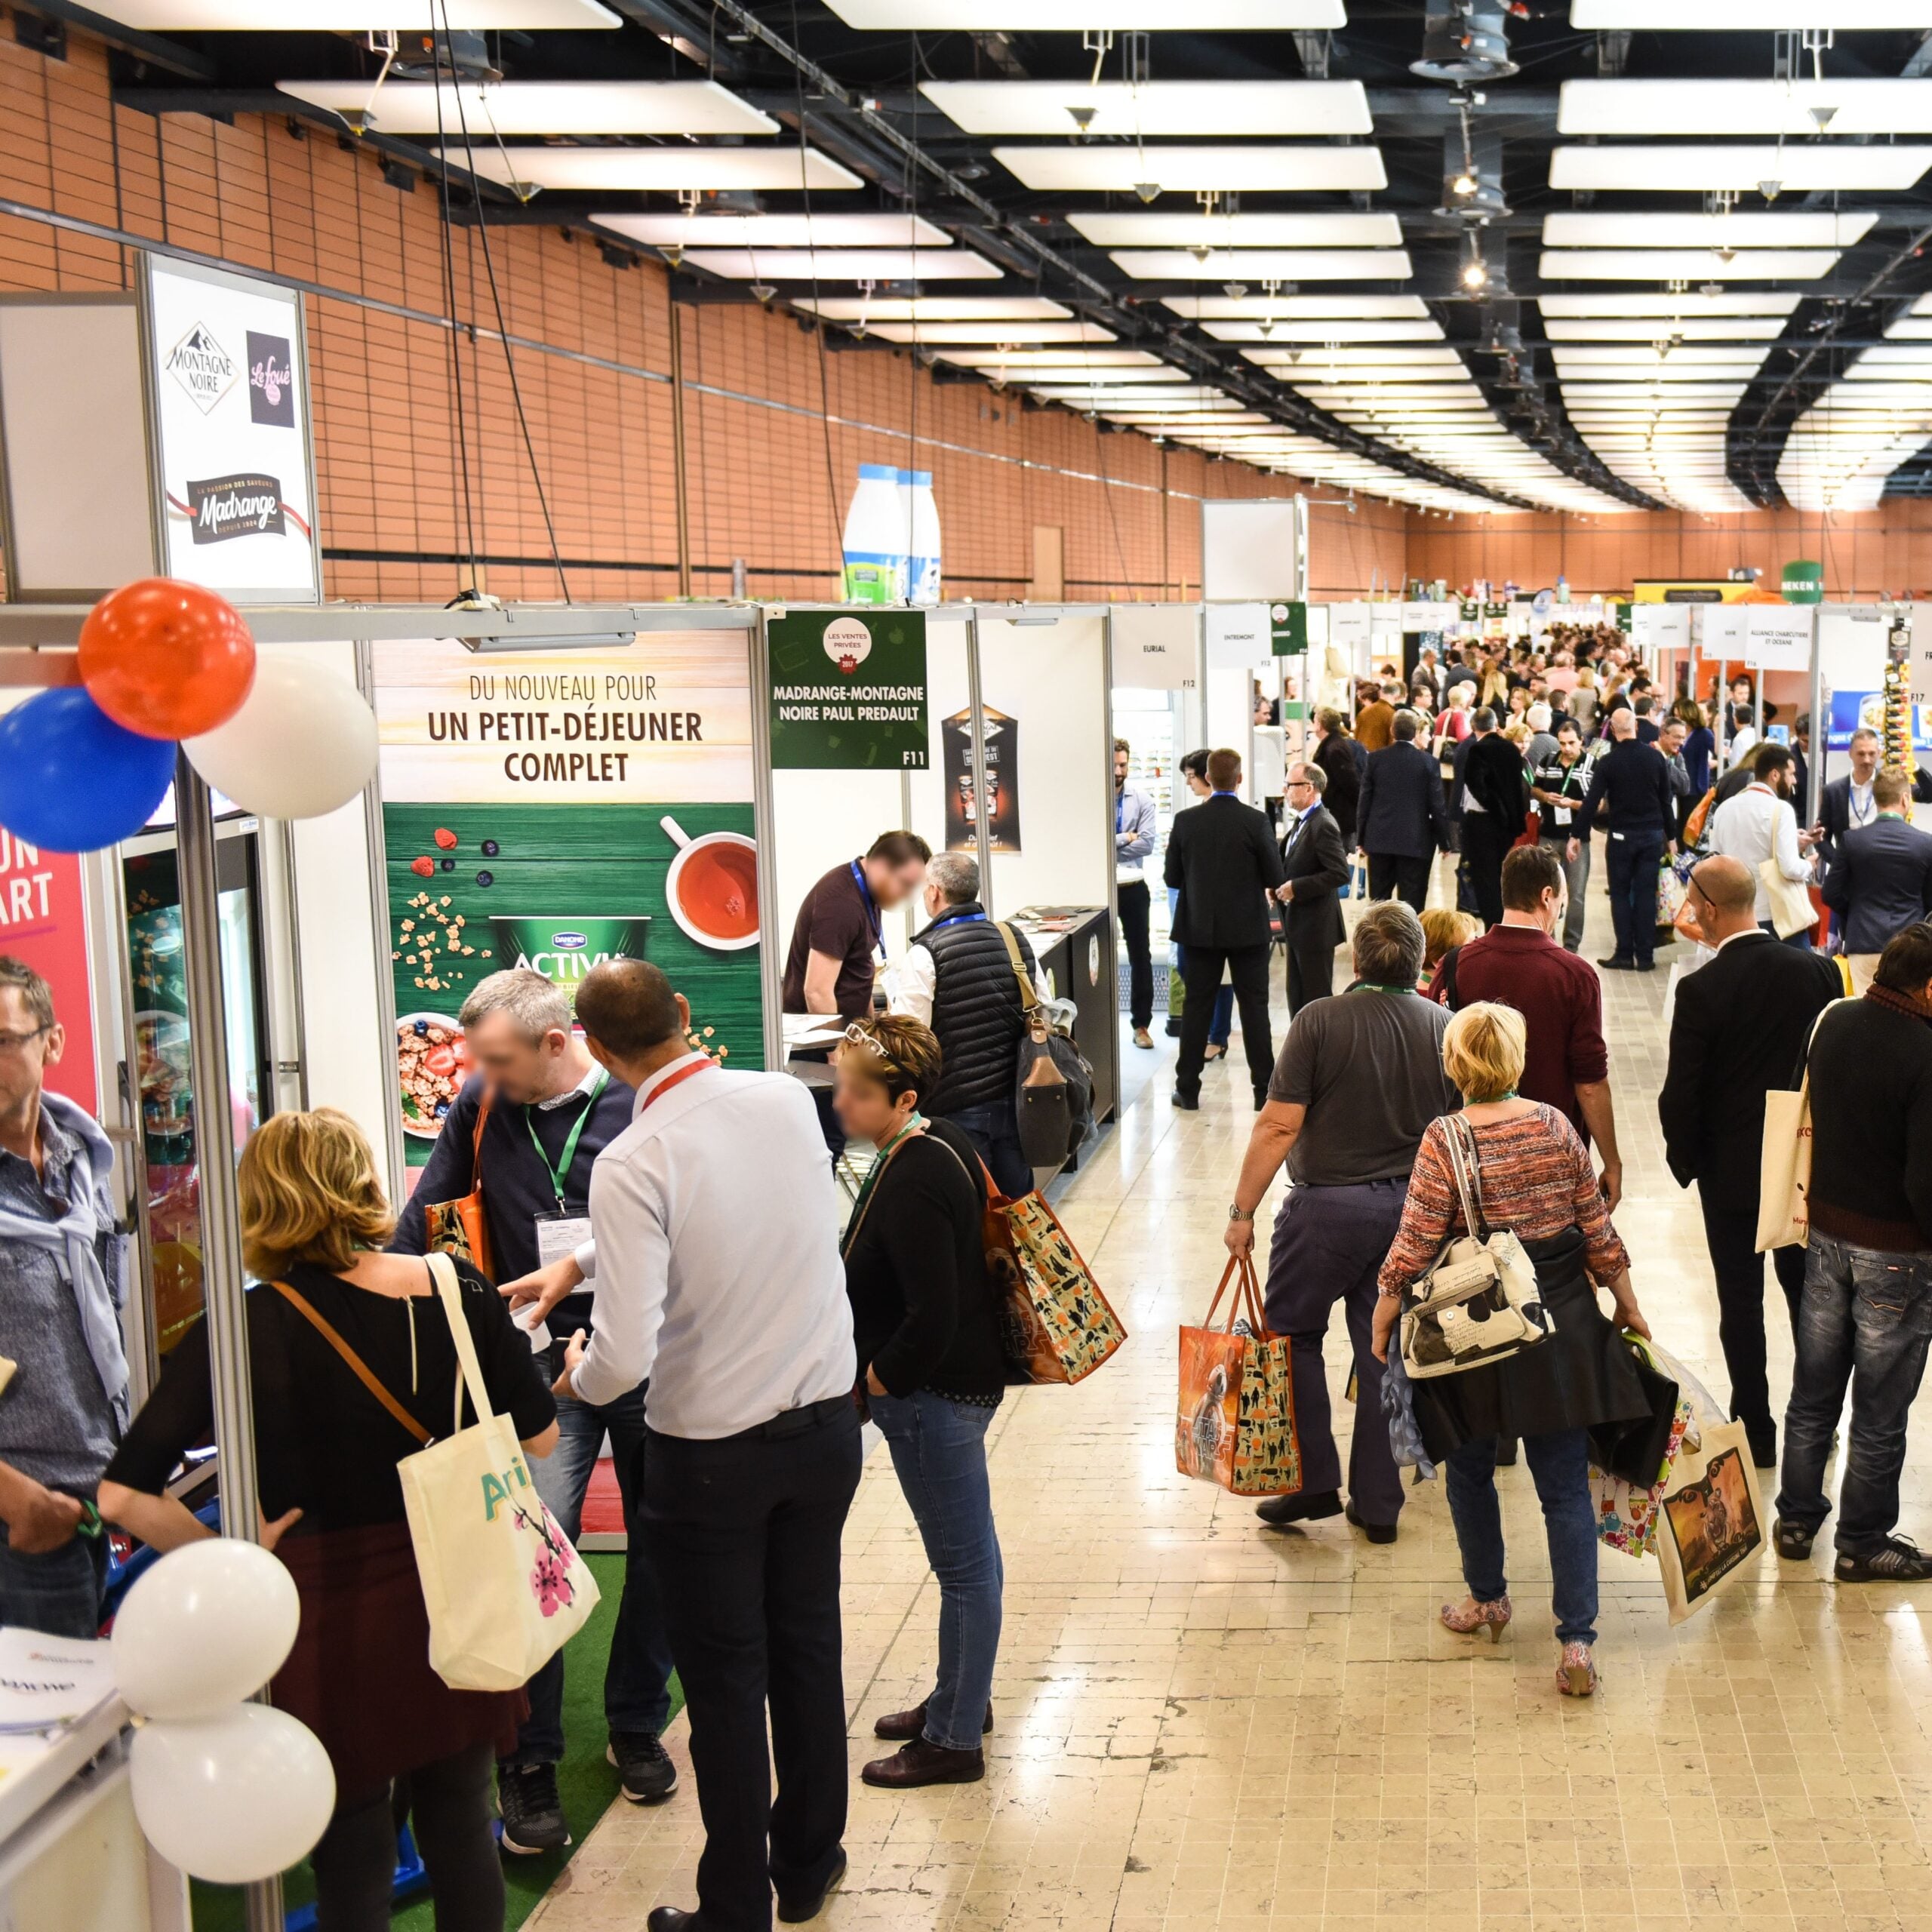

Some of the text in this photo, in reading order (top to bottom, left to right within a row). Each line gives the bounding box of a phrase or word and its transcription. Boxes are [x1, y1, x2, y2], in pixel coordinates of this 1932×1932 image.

[166, 346, 232, 376] MONTAGNE
[189, 373, 219, 392] NOIRE
[208, 483, 233, 493] PASSION
[234, 480, 245, 488] DES
[247, 479, 273, 488] SAVEURS
[199, 491, 277, 534] Madrange
[1143, 645, 1166, 653] EURIAL
[469, 675, 657, 701] DU NOUVEAU POUR
[773, 686, 924, 701] MADRANGE-MONTAGNE
[1911, 694, 1924, 702] F17
[428, 703, 703, 742] UN PETIT-DÉJEUNER
[780, 706, 919, 721] NOIRE PAUL PREDAULT
[504, 752, 629, 781] COMPLET
[903, 751, 924, 765] F11
[513, 952, 623, 979] ACTIV
[481, 1457, 529, 1521] Ari
